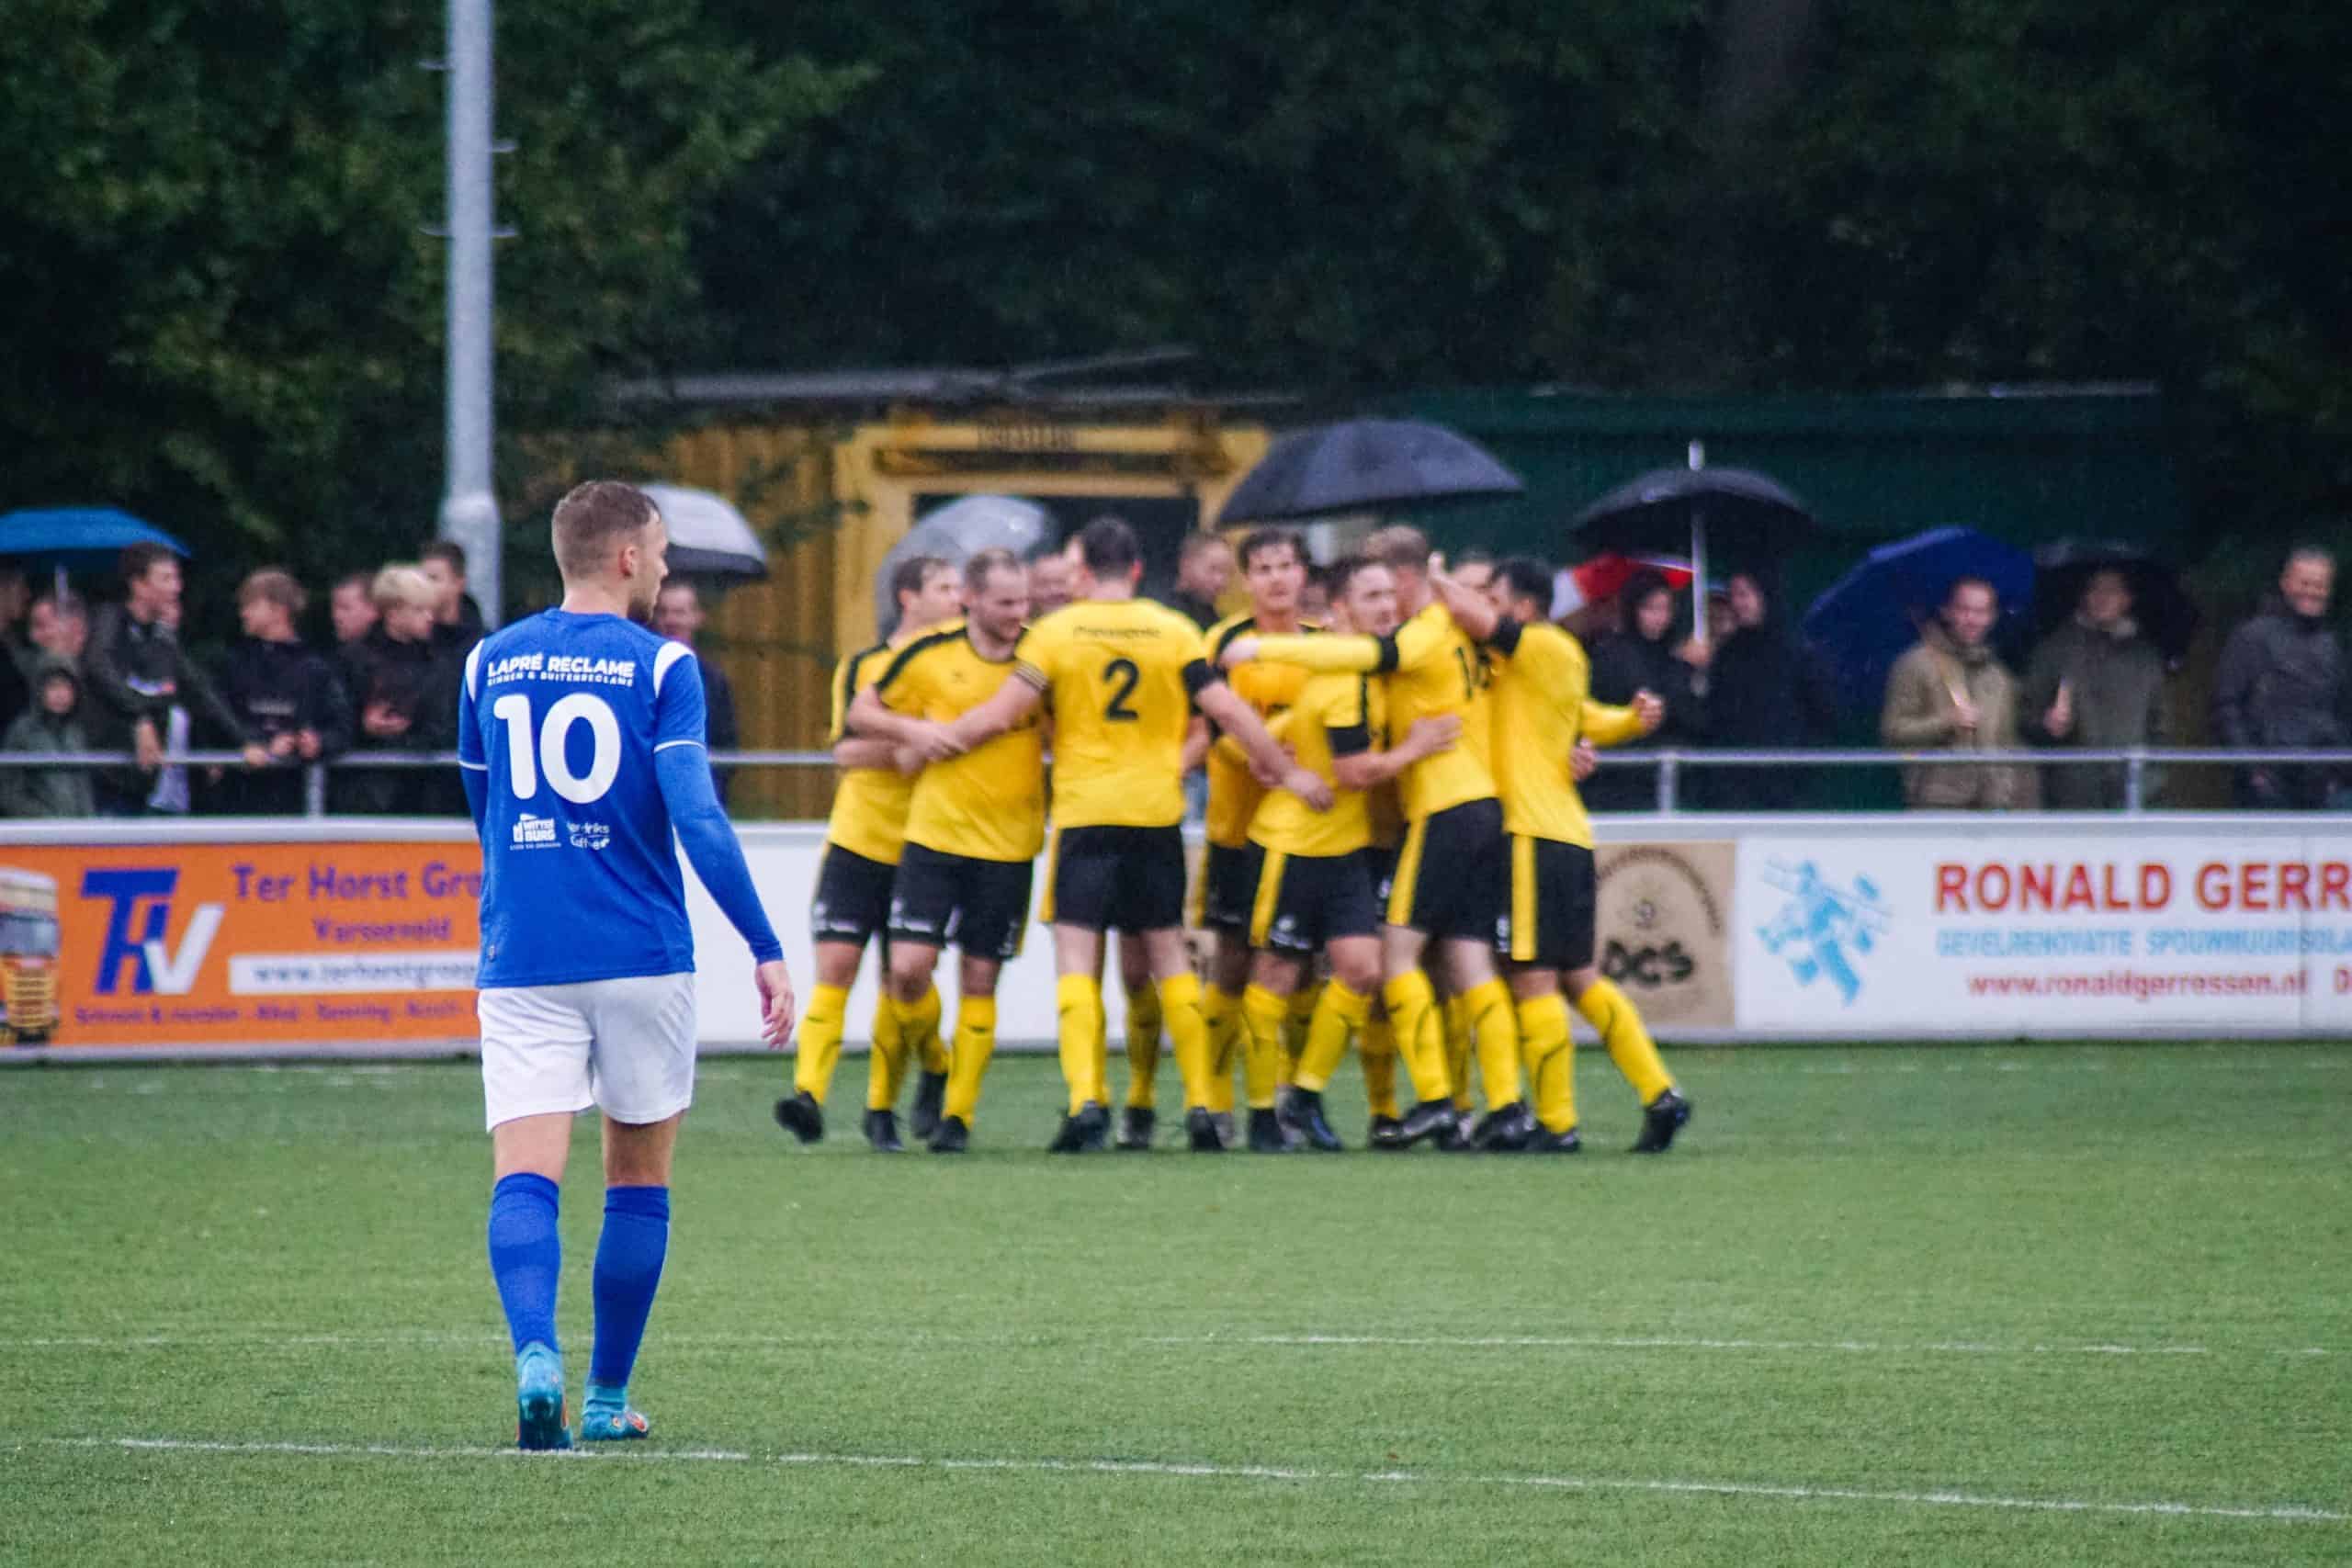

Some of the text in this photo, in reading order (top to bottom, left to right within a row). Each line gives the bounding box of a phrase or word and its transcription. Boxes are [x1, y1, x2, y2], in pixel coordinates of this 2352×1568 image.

[487, 652, 636, 678] LAPRÉ RECLAME
[1102, 658, 1140, 722] 2
[493, 693, 621, 804] 10
[233, 862, 481, 900] Ter Horst Gro
[1934, 863, 2351, 912] RONALD GERR
